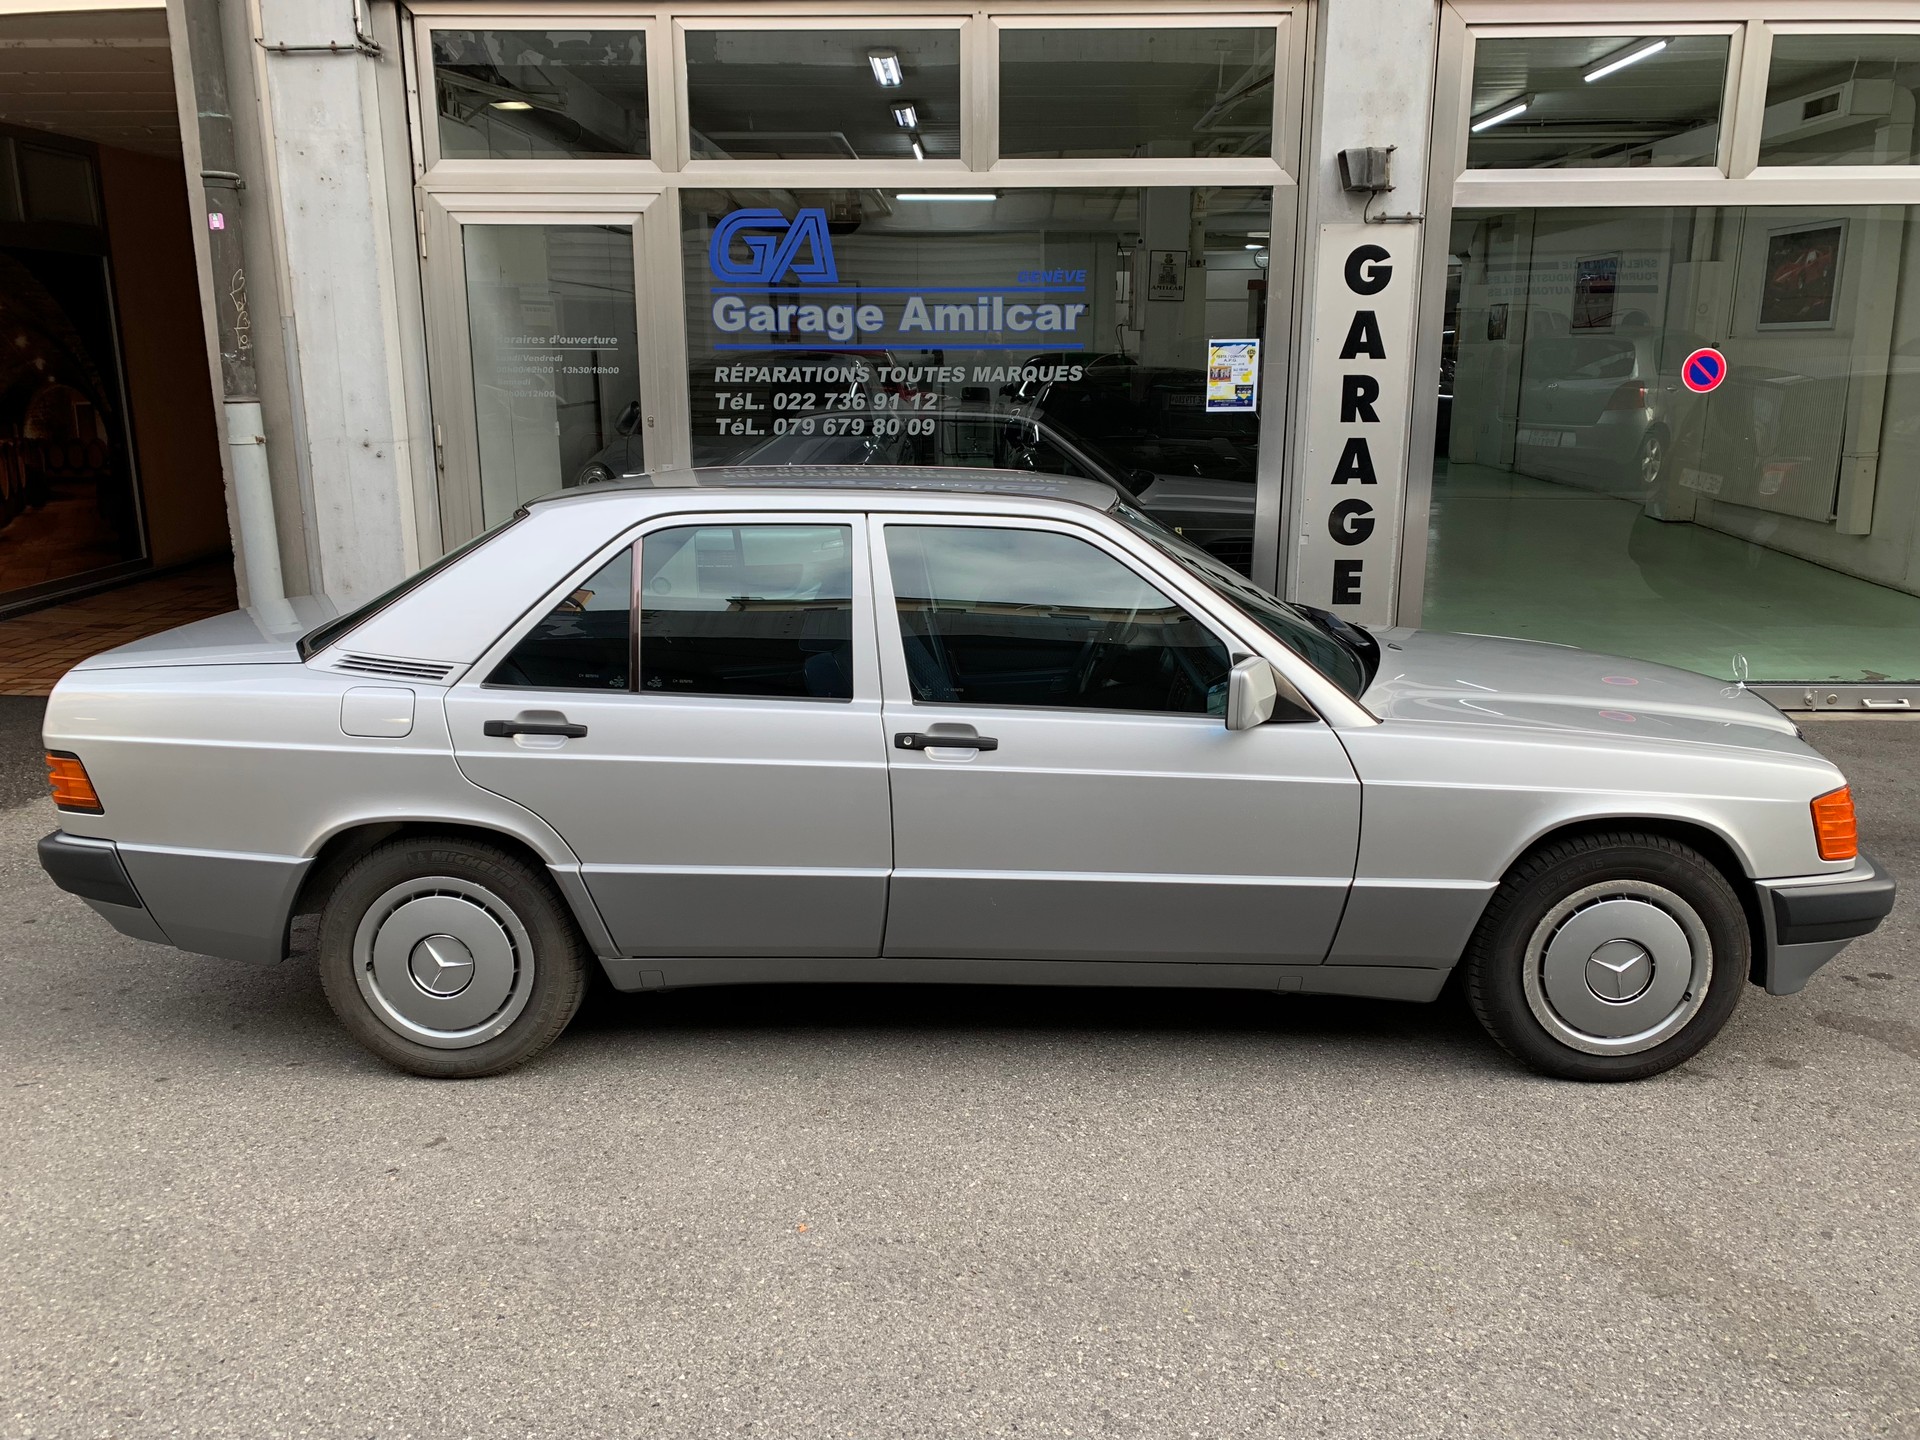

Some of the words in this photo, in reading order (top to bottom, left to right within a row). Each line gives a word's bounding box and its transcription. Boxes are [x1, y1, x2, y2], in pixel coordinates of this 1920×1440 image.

[709, 208, 839, 283] GA
[712, 296, 884, 341] Garage
[899, 296, 1085, 331] Amilcar
[562, 366, 620, 374] 13h30/18h00
[714, 363, 870, 383] RÉPARATIONS
[877, 366, 966, 383] TOUTES
[971, 365, 1083, 383] MARQUES
[715, 392, 764, 411] TéL.
[773, 392, 815, 411] 022
[825, 392, 866, 411] 736
[873, 392, 905, 411] 91
[909, 392, 937, 411] 12
[715, 417, 764, 436] TéL.
[773, 417, 815, 436] 079
[823, 417, 865, 436] 679
[872, 417, 899, 436] 80
[906, 417, 935, 436] 09
[1328, 244, 1393, 605] GARAGE
[430, 850, 520, 889] MICHELIN
[1536, 868, 1577, 899] 185/65
[1590, 858, 1604, 870] 15
